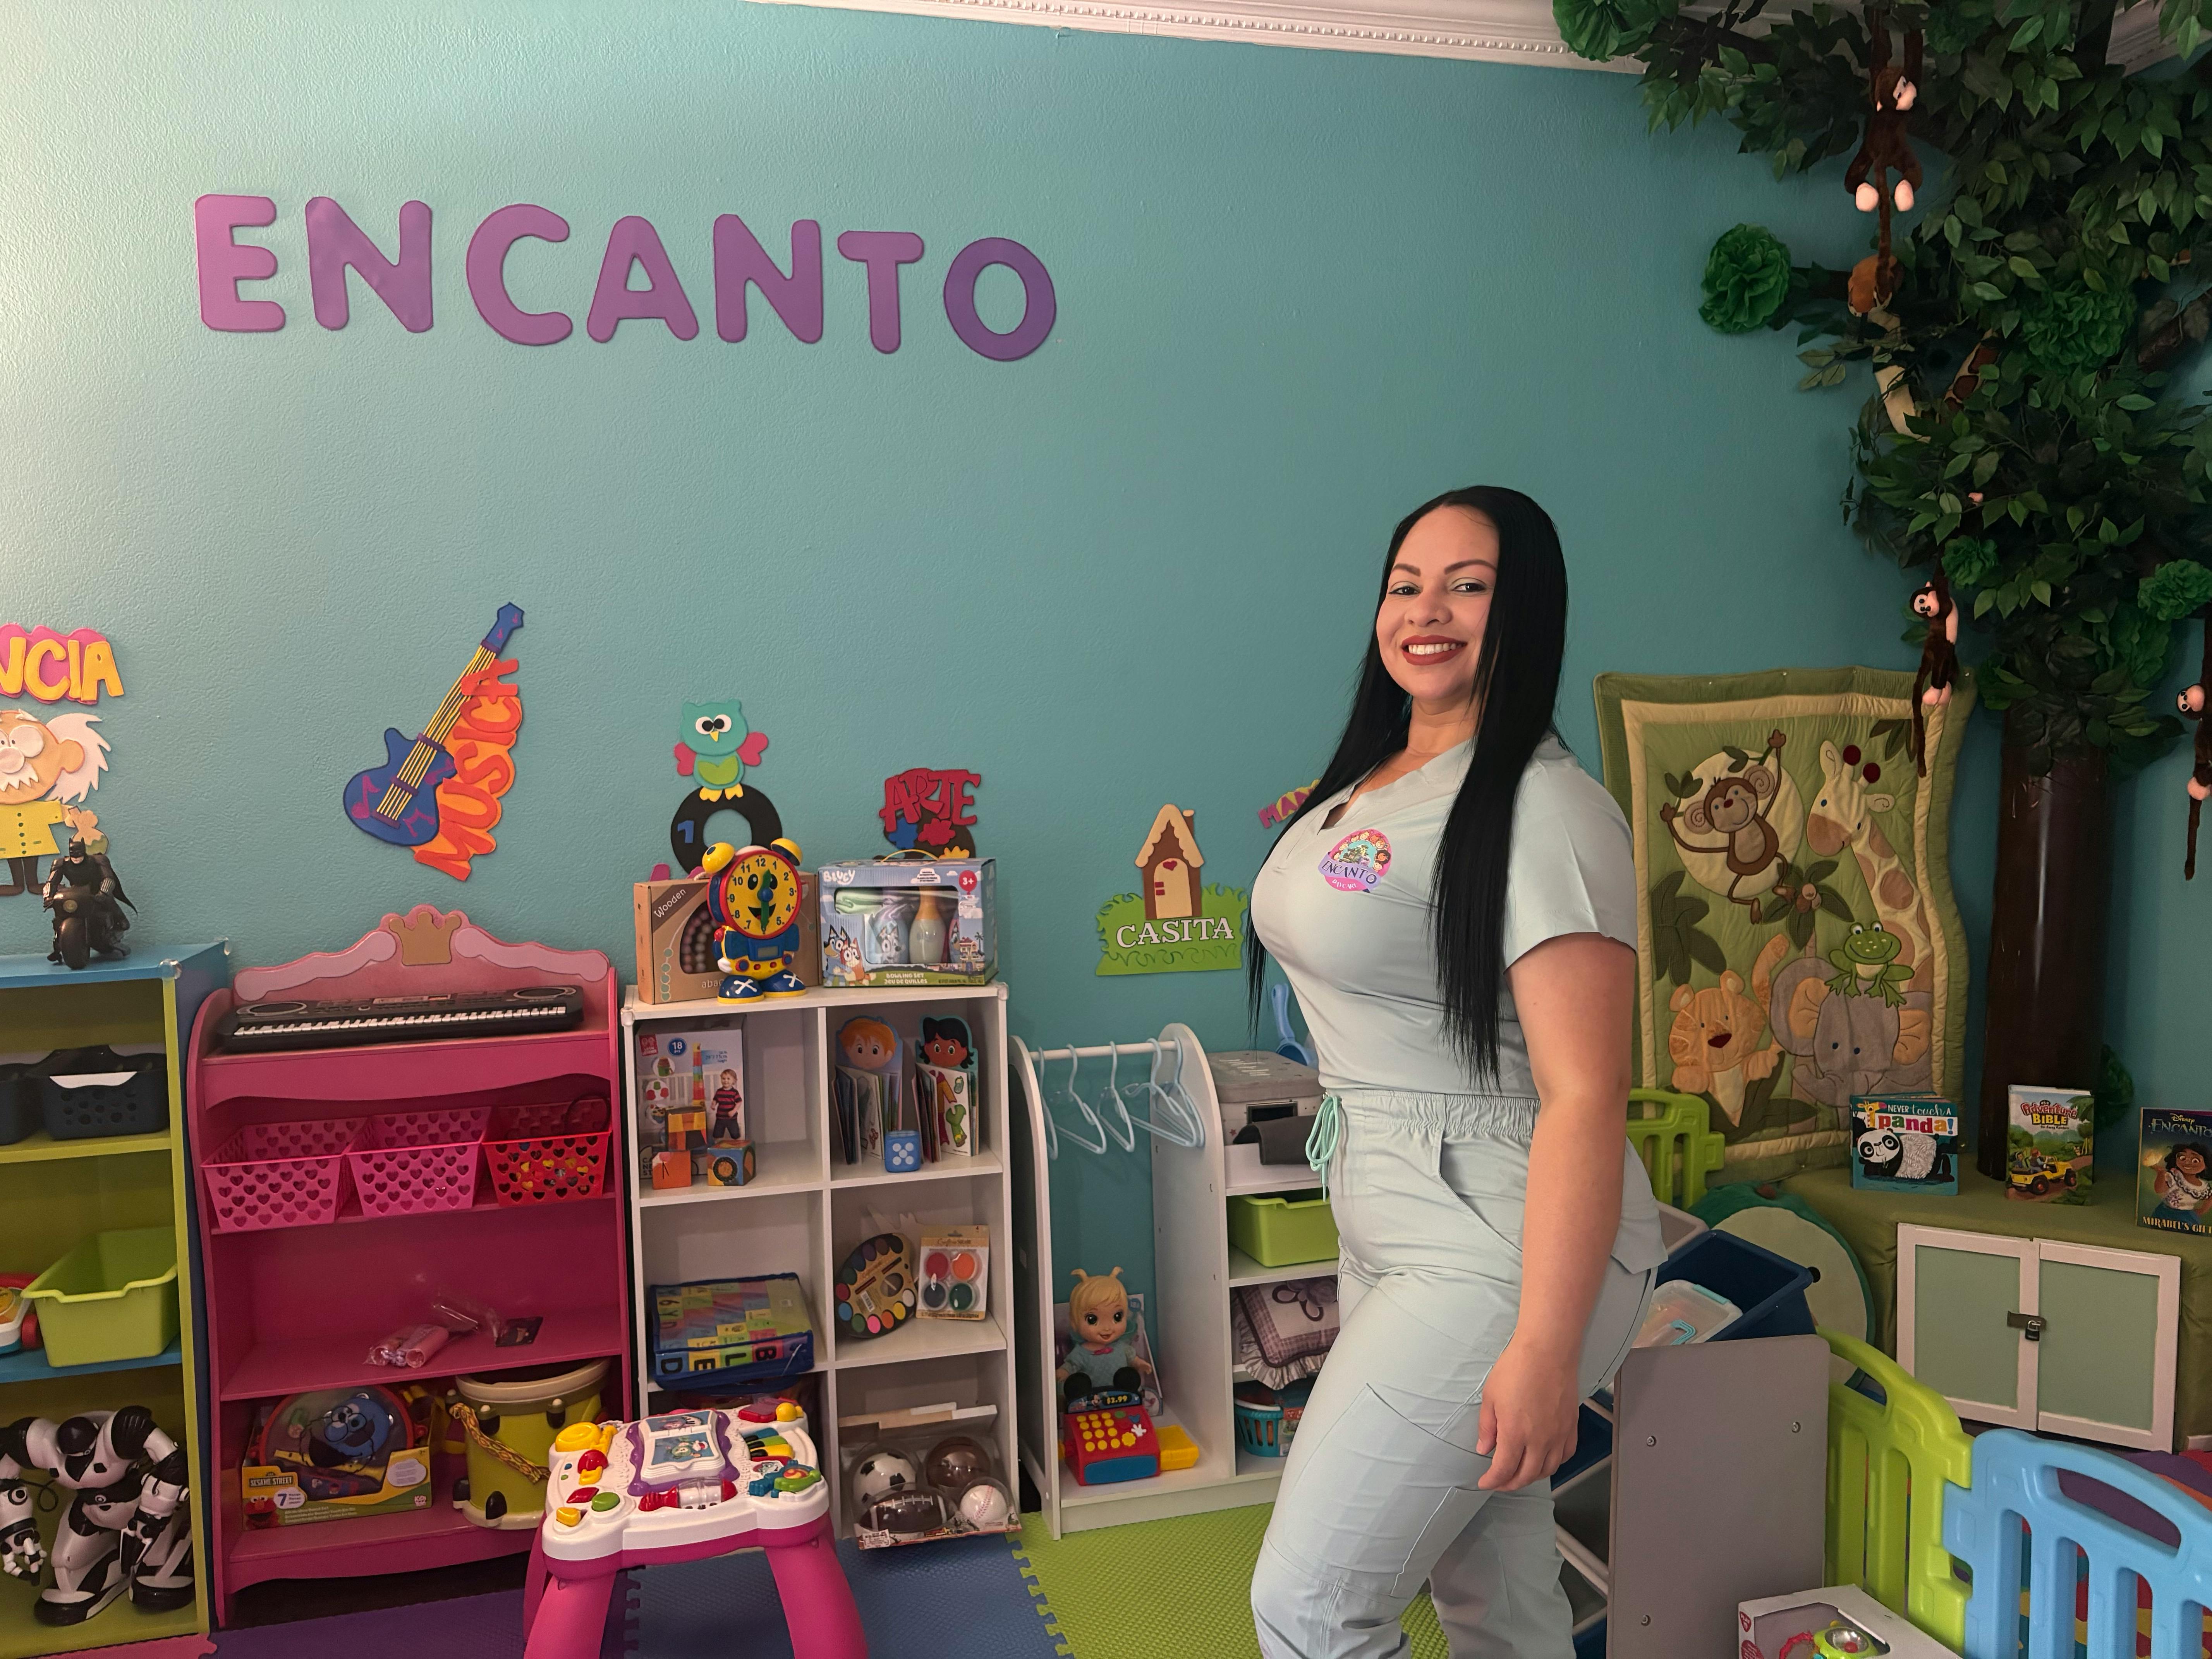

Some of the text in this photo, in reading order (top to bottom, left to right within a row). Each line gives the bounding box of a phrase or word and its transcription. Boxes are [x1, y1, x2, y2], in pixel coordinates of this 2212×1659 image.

[194, 194, 1057, 361] ENCANTO
[879, 768, 981, 832] ARTE
[756, 858, 766, 867] 12
[773, 860, 777, 870] 1
[741, 864, 750, 873] 11
[1322, 860, 1377, 884] ENCANTO
[732, 876, 743, 886] 10
[783, 872, 789, 881] 2
[823, 869, 855, 885] BLUEY
[962, 877, 974, 885] 3+
[789, 888, 794, 896] 3
[729, 893, 735, 903] 9
[653, 888, 686, 919] Wooden
[786, 903, 791, 912] 4
[735, 910, 740, 919] 8
[746, 920, 751, 929] 7
[776, 916, 781, 926] 5
[1116, 917, 1234, 948] CASITA
[672, 1041, 682, 1049] 18
[1888, 1104, 1909, 1113] NEVER
[1911, 1104, 1945, 1116] touch
[2020, 1102, 2078, 1120] Adventure
[2032, 1113, 2068, 1125] BIBLE
[2169, 1113, 2195, 1125] Disney
[1878, 1115, 1954, 1135] panda!
[1106, 1395, 1127, 1405] $2.99
[251, 1476, 292, 1487] SESAME STREET
[278, 1493, 287, 1506] 7
